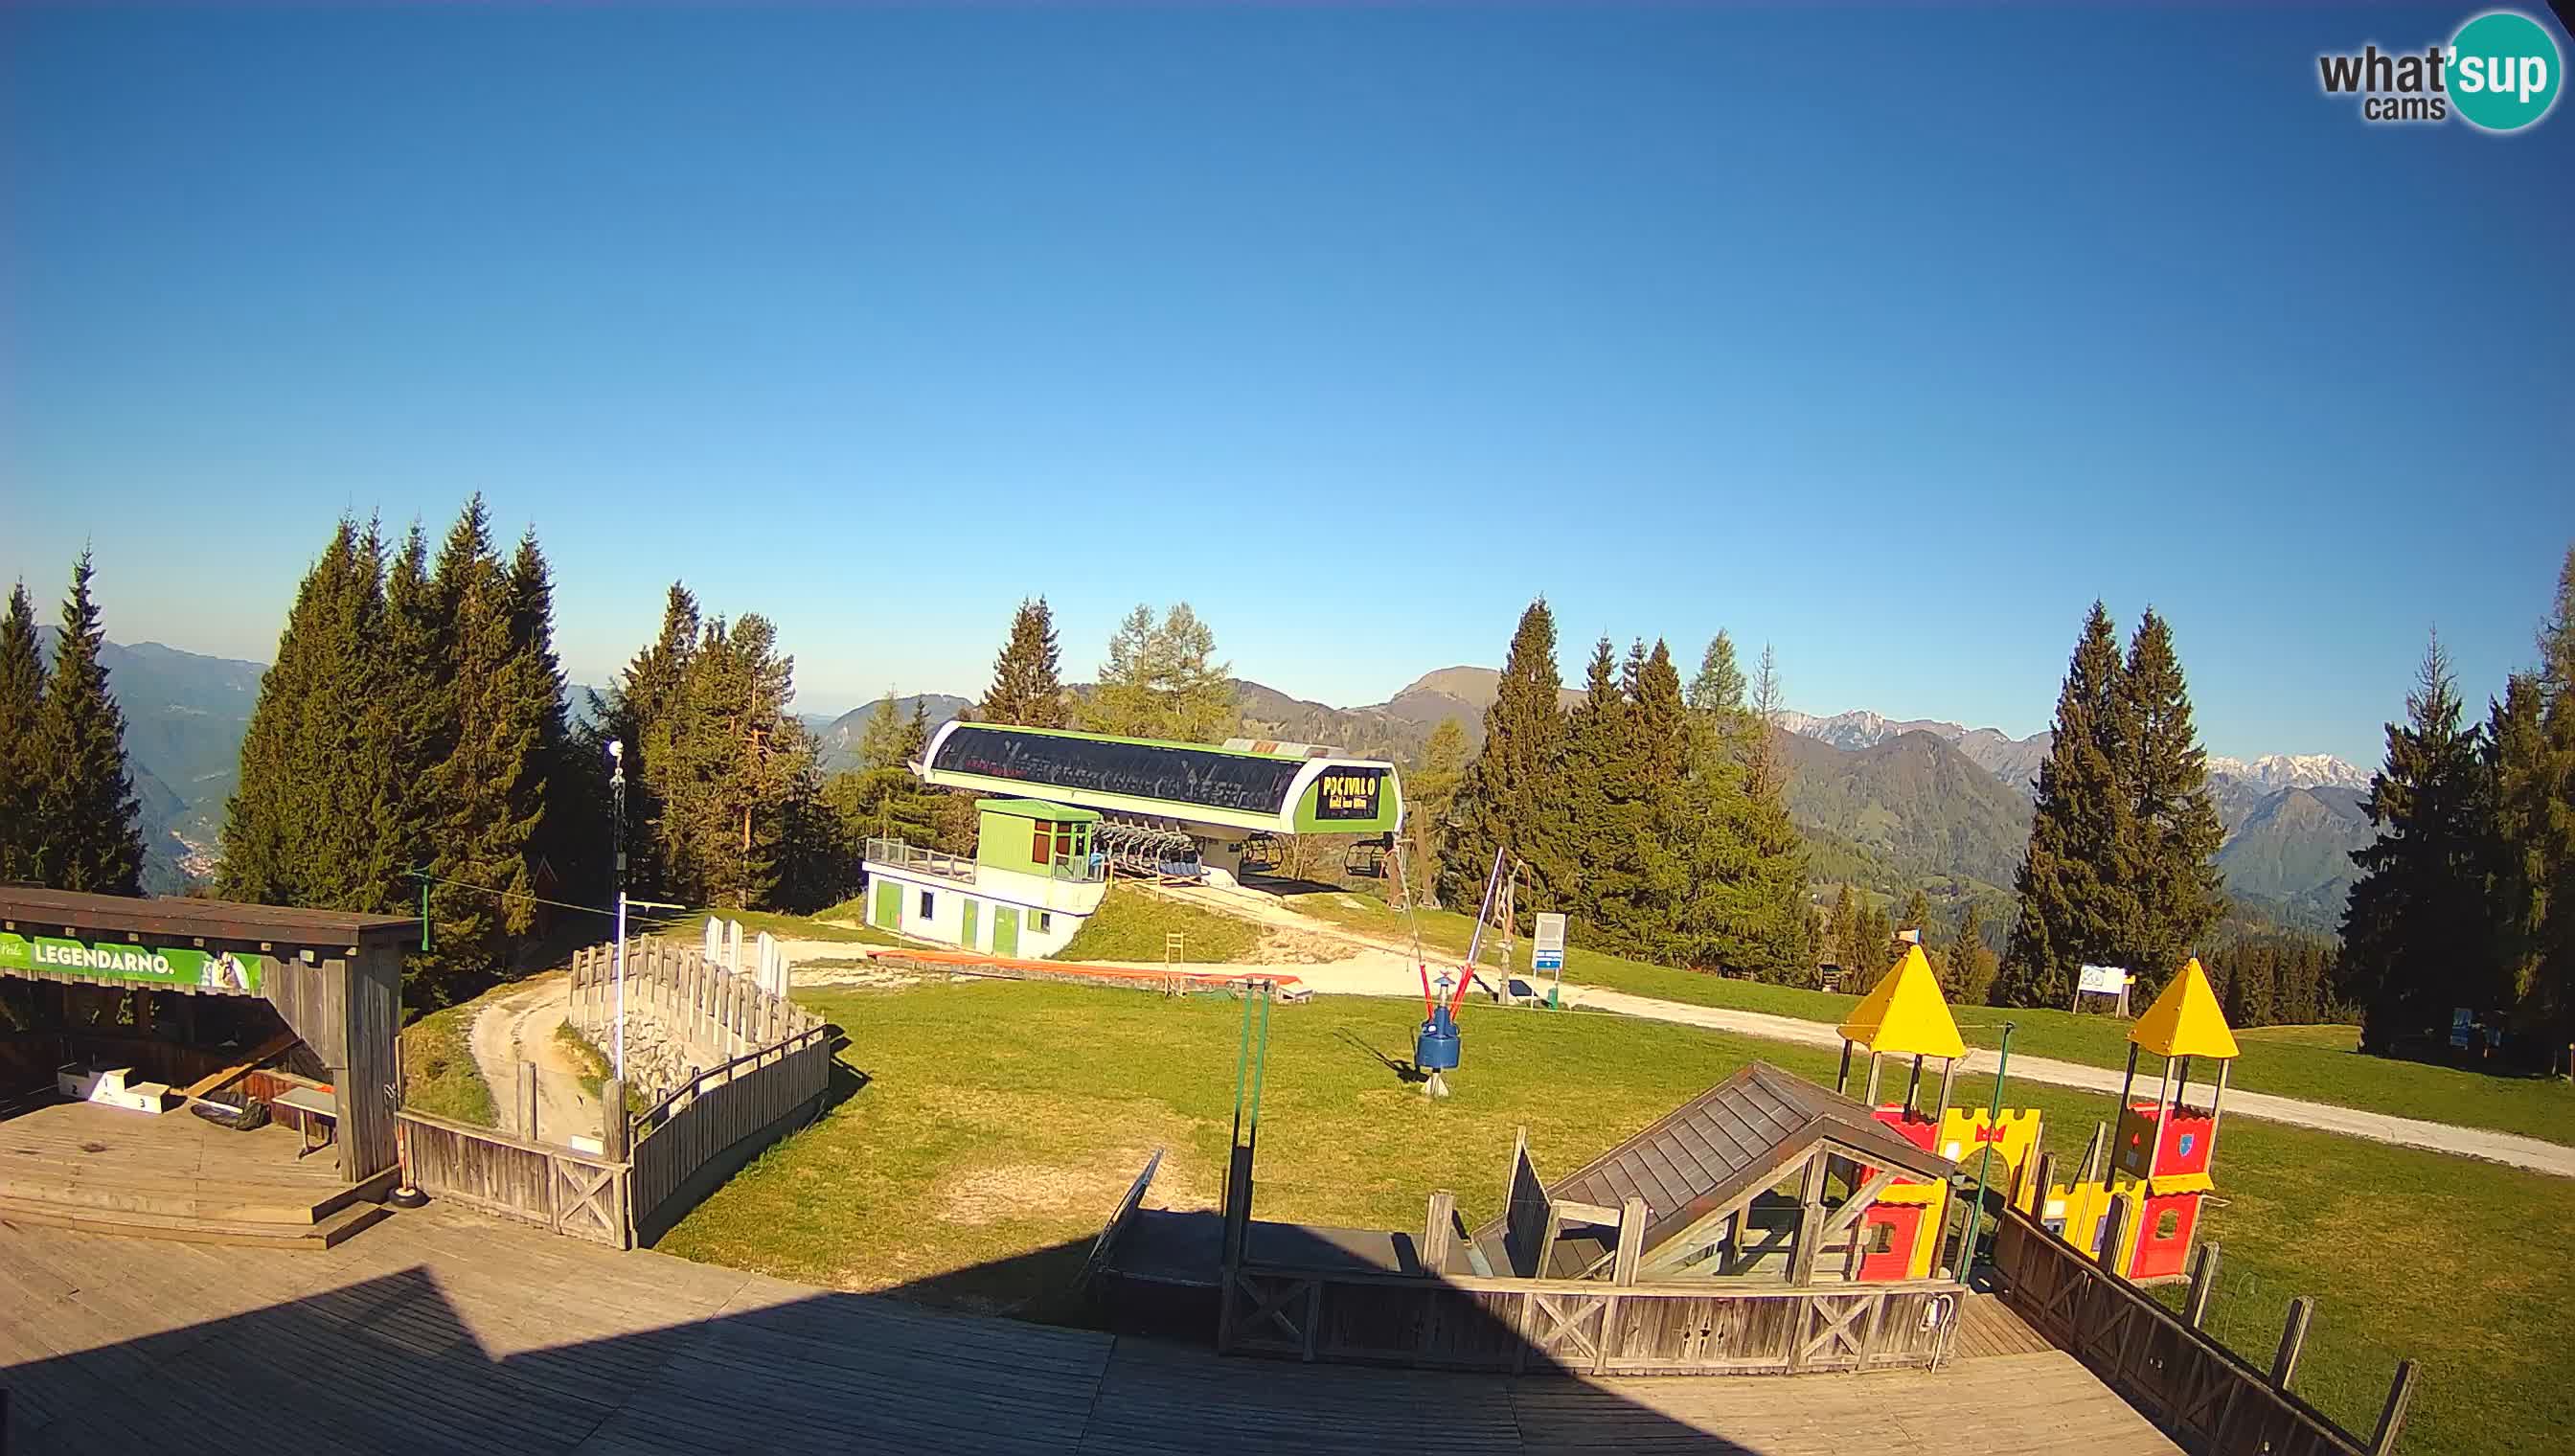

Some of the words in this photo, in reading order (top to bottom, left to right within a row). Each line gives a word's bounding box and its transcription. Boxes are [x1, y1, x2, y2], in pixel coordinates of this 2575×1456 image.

[34, 944, 175, 975] LEGENDARNO.
[72, 1084, 78, 1094] 2
[139, 1098, 146, 1108] 3
